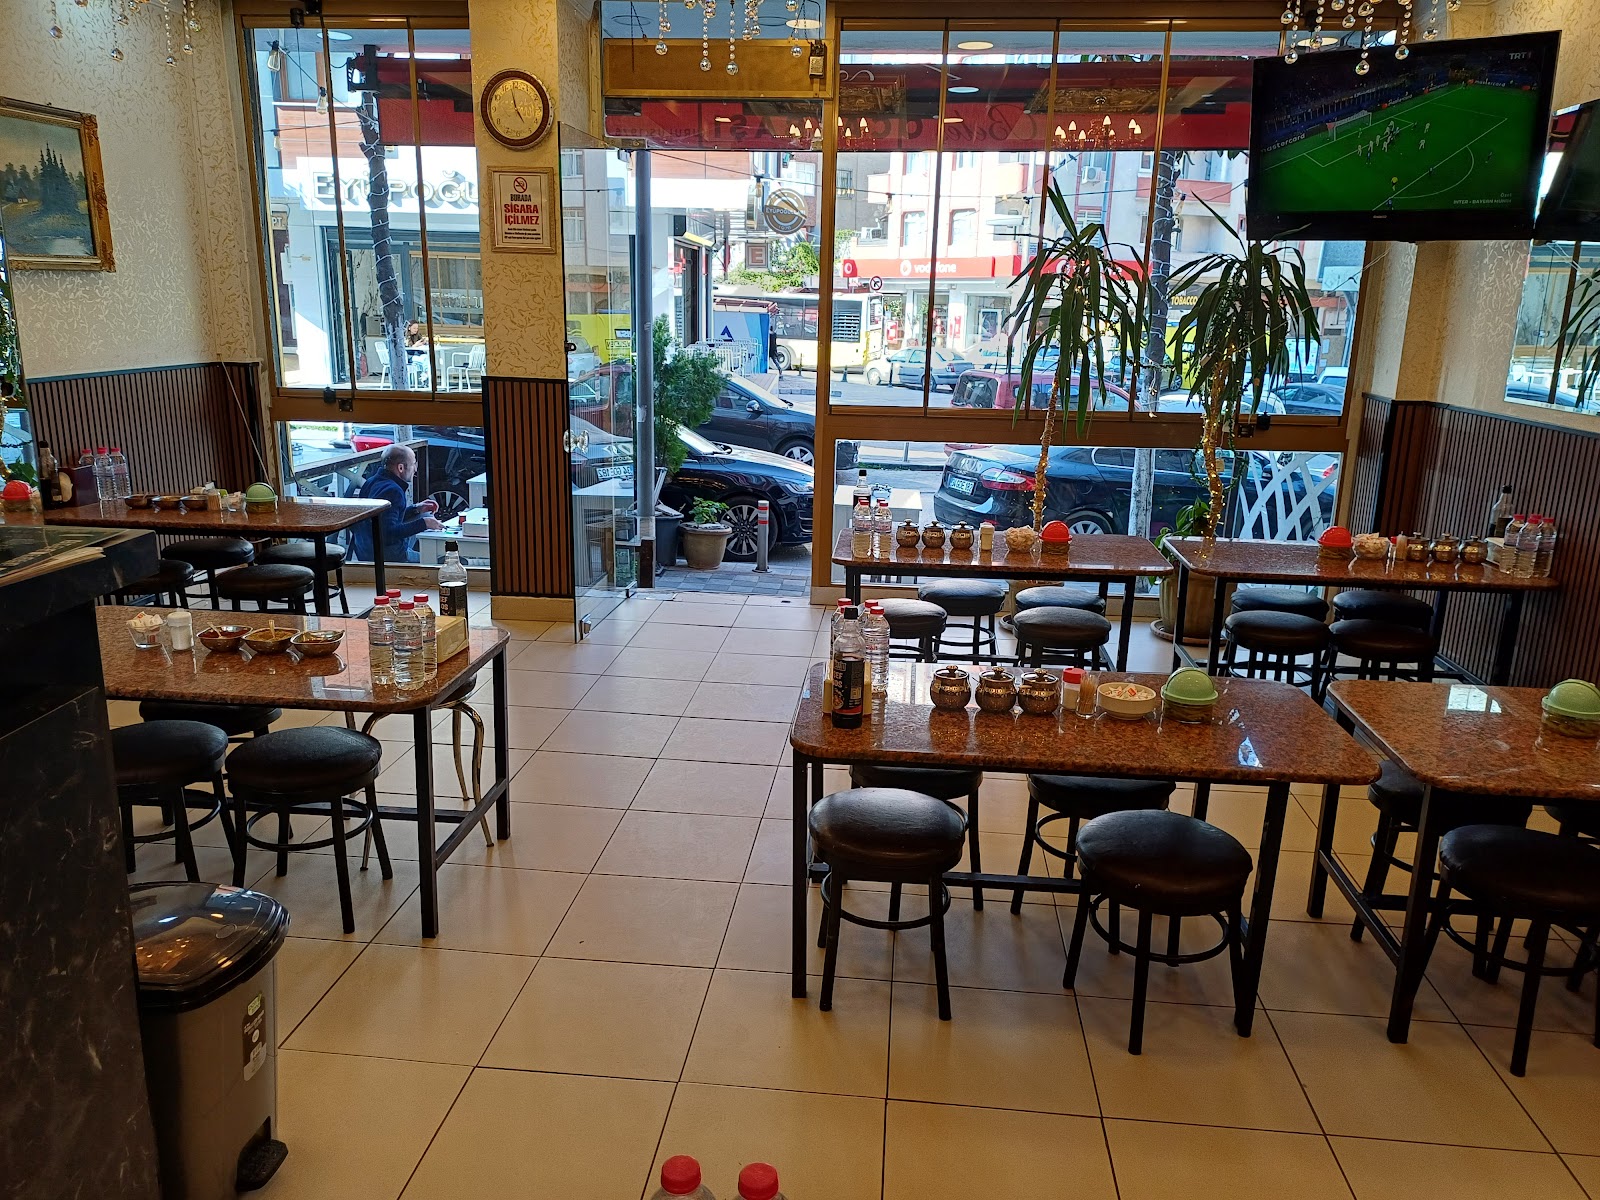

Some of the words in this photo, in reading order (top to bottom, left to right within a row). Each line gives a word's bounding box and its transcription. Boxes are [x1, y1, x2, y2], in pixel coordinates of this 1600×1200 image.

[1508, 51, 1526, 60] TRT
[510, 193, 532, 202] BURADA
[503, 202, 539, 214] SİGARA
[504, 214, 540, 226] İÇİLMEZ
[751, 248, 764, 264] E
[914, 261, 957, 273] vodfone
[1170, 296, 1199, 306] TOBACCO
